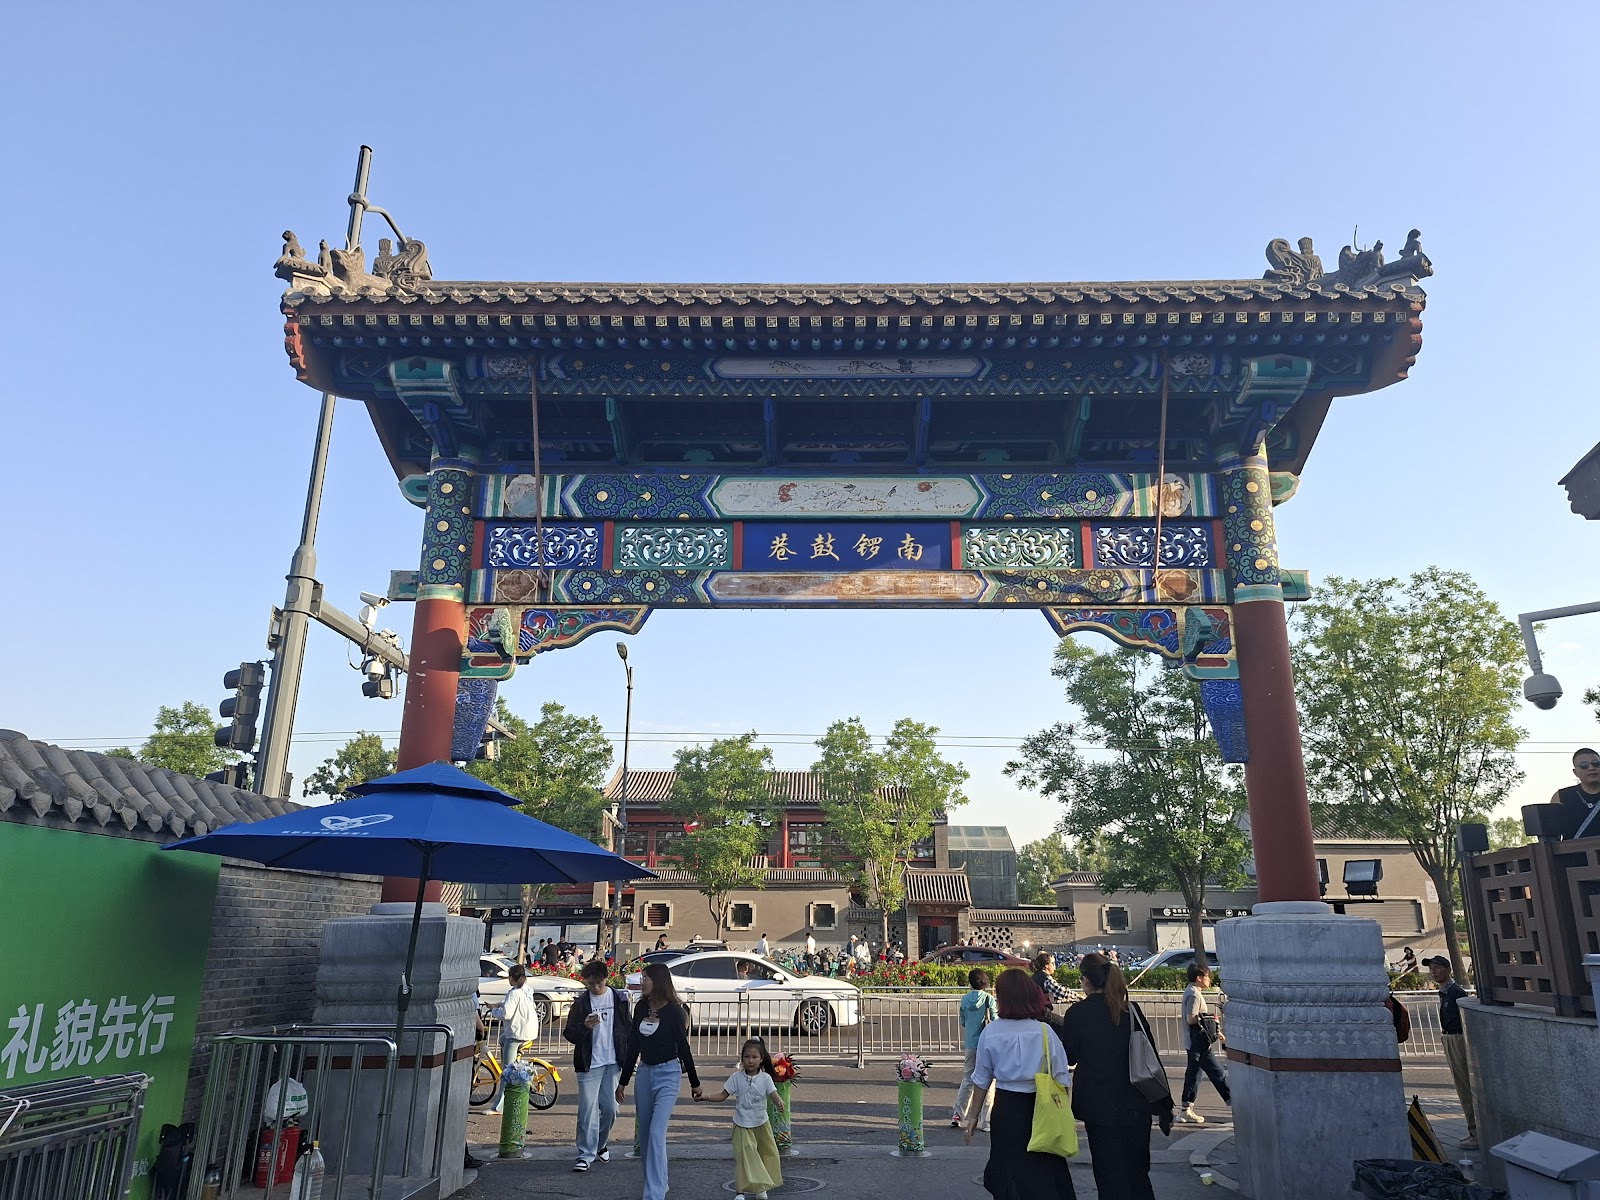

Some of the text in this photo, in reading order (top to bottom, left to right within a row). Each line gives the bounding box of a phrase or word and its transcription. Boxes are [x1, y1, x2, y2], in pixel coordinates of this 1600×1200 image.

[768, 532, 924, 562] 南锣鼓巷
[1, 993, 176, 1079] 礼貌先行
